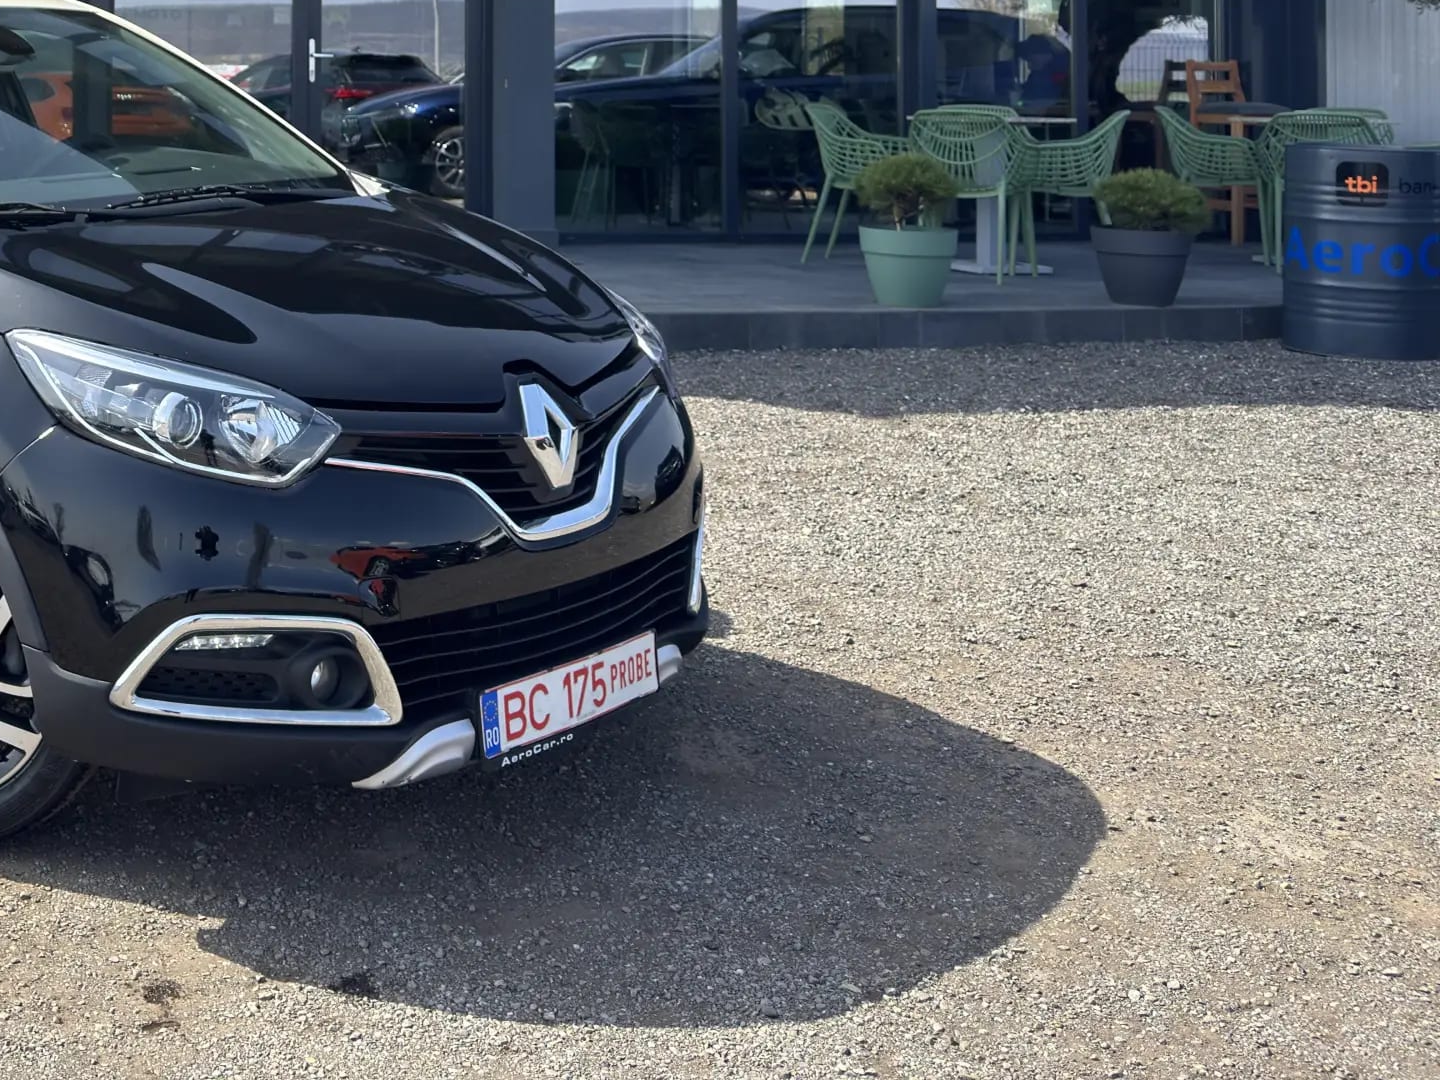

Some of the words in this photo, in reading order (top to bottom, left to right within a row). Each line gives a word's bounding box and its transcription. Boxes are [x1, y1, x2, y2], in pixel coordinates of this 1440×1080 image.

[1345, 175, 1378, 194] tbi
[503, 683, 551, 742] BC
[563, 661, 607, 719] 175
[610, 648, 652, 693] PROBE
[485, 727, 500, 749] RO
[501, 732, 573, 767] AeroCar.ro
